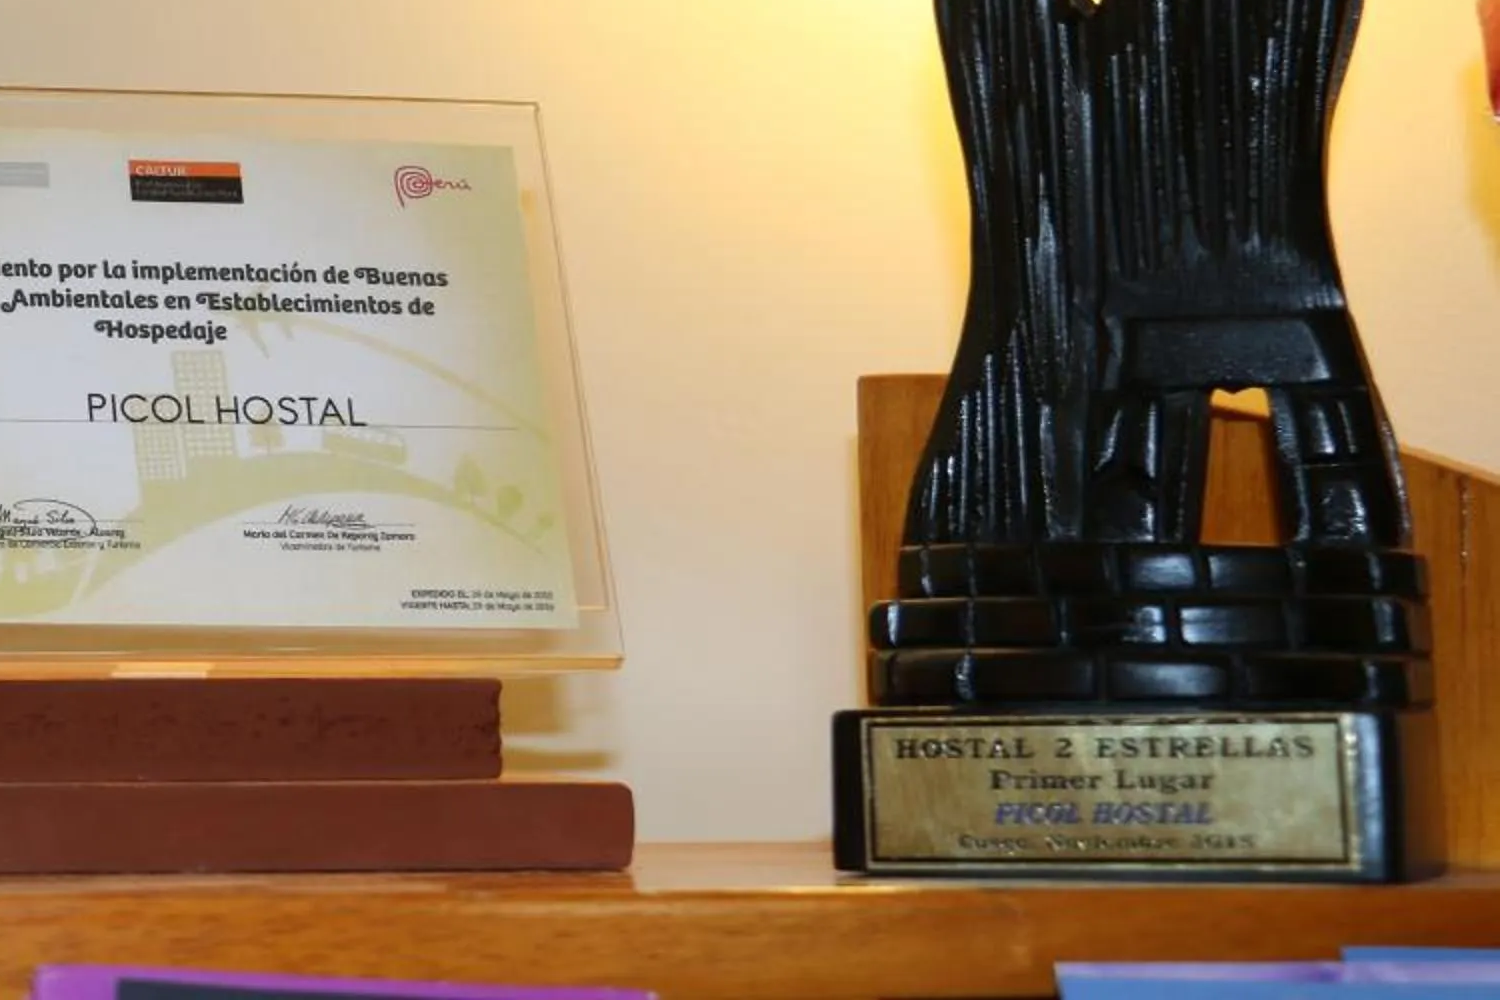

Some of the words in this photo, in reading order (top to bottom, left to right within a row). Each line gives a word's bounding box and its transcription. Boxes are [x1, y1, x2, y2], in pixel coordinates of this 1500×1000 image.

[58, 262, 98, 282] por
[103, 260, 127, 279] la
[132, 260, 317, 285] implementación
[324, 266, 349, 284] de
[354, 267, 448, 288] Buenas
[0, 289, 159, 313] Ambientales
[164, 295, 191, 310] en
[195, 292, 403, 315] Establecimientos
[408, 297, 436, 315] de
[94, 319, 227, 344] Hospedaje
[87, 393, 205, 423] PICOL
[215, 395, 368, 427] HOSTAL
[894, 737, 1035, 760] HOSTAL
[1054, 737, 1074, 759] 2
[1098, 736, 1316, 760] ESTRELLAS
[989, 768, 1101, 791] Primer
[1115, 769, 1215, 793] Lugar
[994, 801, 1079, 825] PICOL
[1092, 801, 1215, 825] HOSTAL
